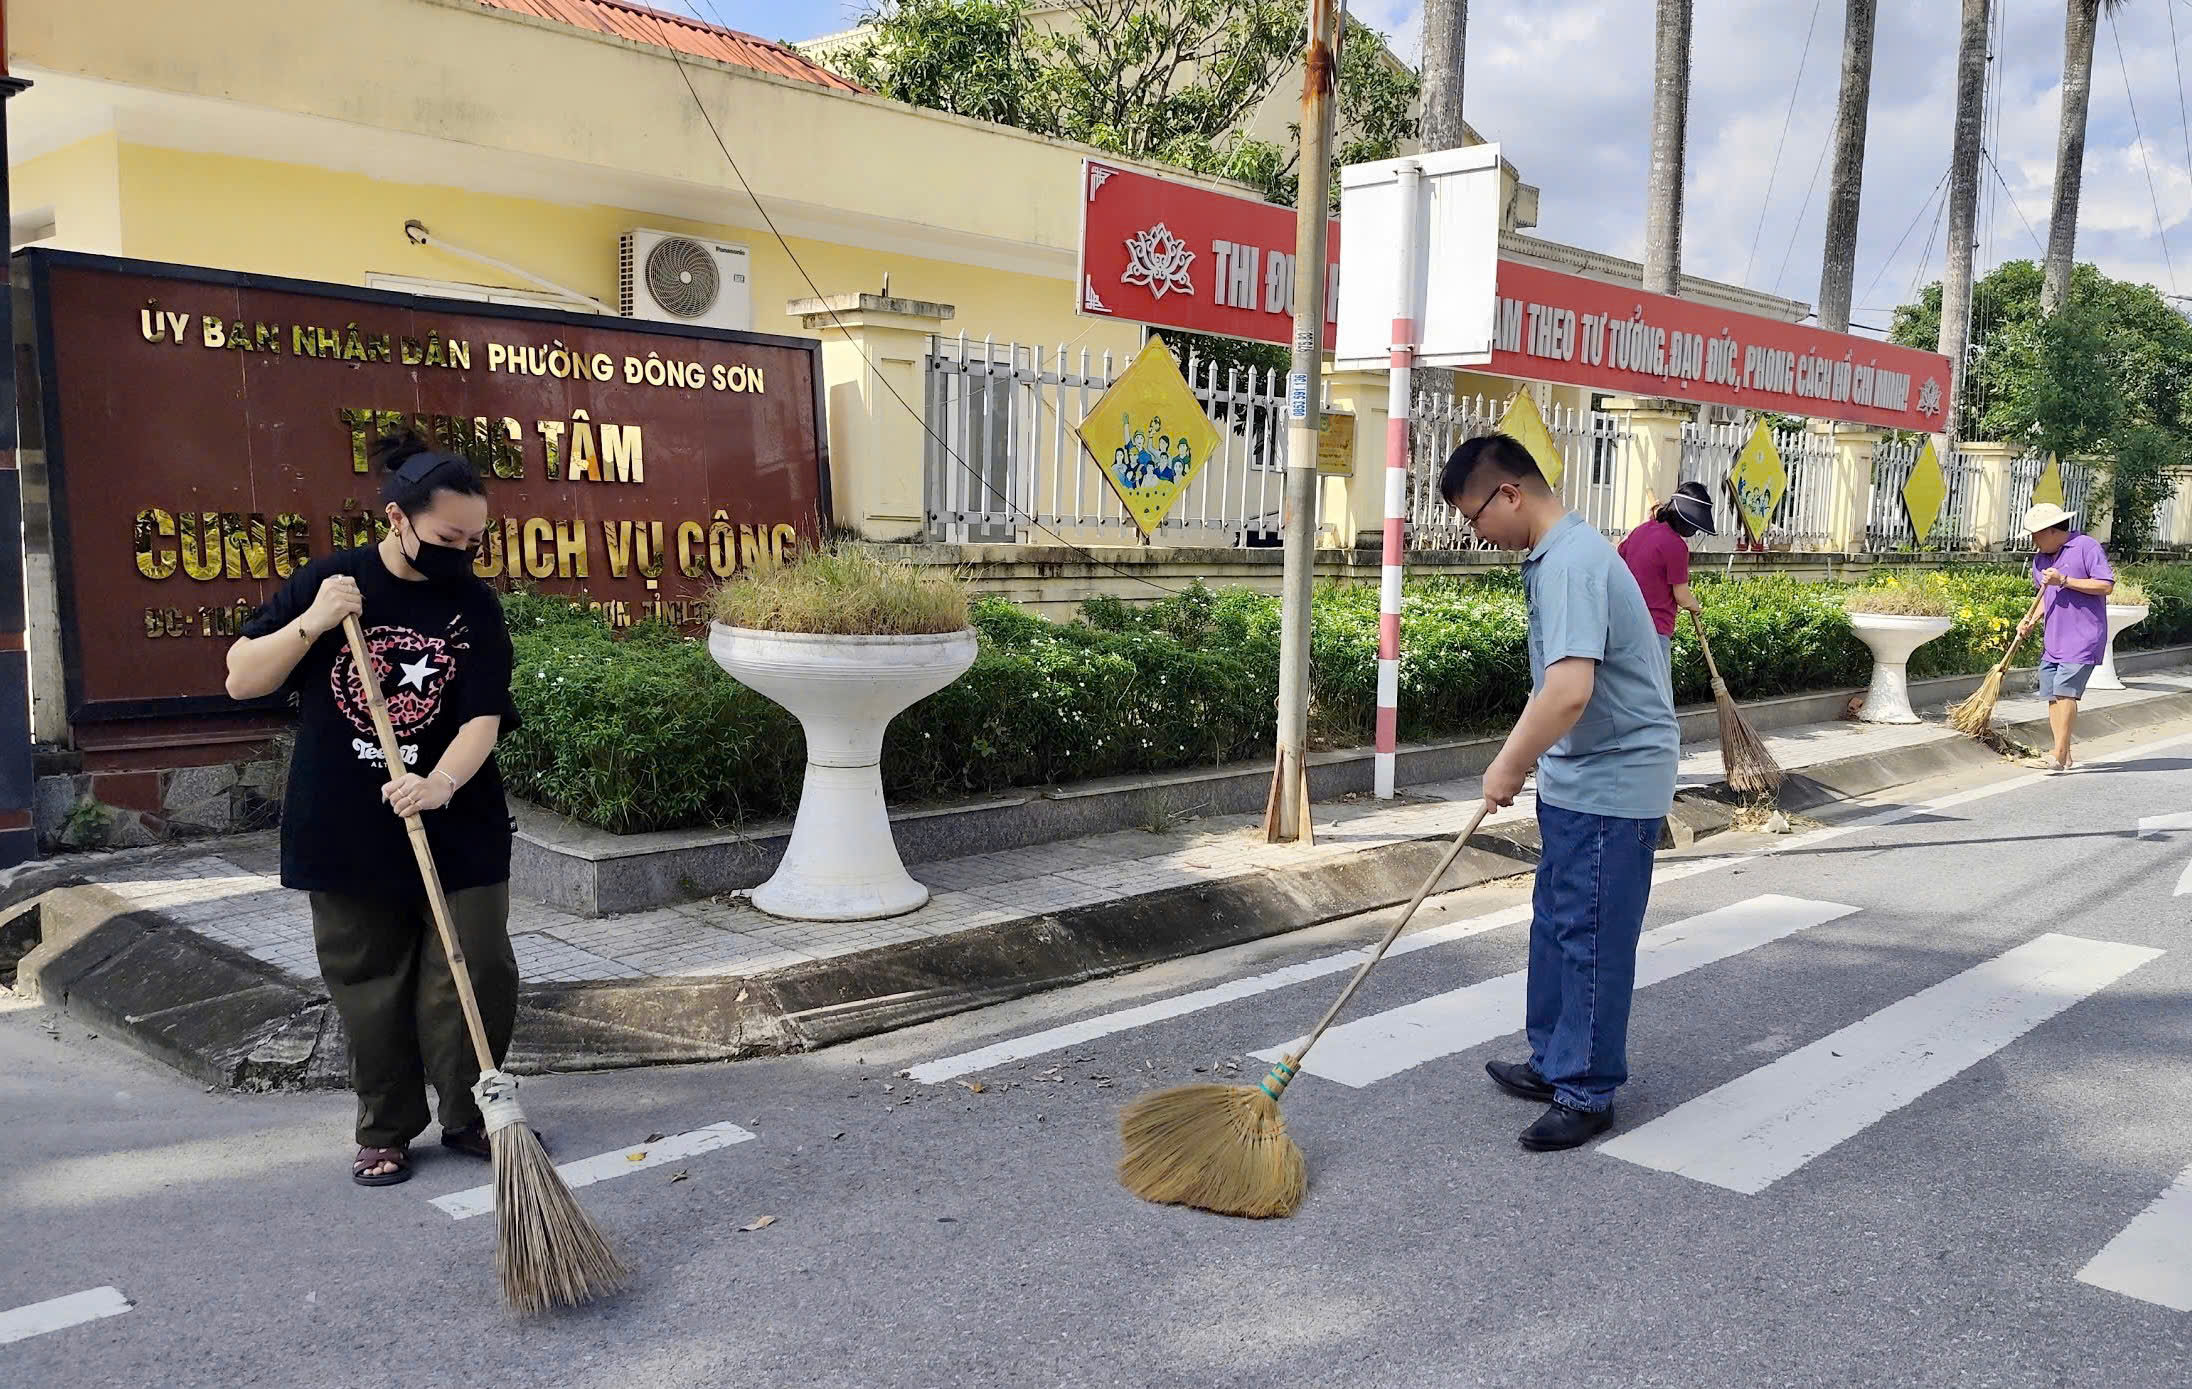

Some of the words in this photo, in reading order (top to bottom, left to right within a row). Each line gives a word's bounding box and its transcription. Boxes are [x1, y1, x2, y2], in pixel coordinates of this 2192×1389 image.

[140, 297, 190, 344] ỦY
[202, 315, 281, 354] BAN
[292, 321, 392, 363] NHÂN
[400, 328, 471, 370] DÂN
[488, 339, 614, 382] PHƯỜNG
[623, 351, 706, 389] ĐÔNG
[711, 363, 765, 393] SƠN
[1212, 239, 1259, 310] THI
[1527, 302, 1576, 362] THEO
[1581, 311, 1608, 367] TƯ
[1669, 330, 1703, 388] ĐẠO
[1742, 344, 1795, 395] PHONG
[1796, 346, 1833, 399] CÁCH
[1832, 348, 1852, 403] HỒ
[1852, 359, 1877, 406] CHÍ
[537, 408, 645, 483] TÂM
[134, 507, 310, 581] CUNG
[604, 520, 664, 590] VỤ
[678, 509, 797, 578] CÔNG
